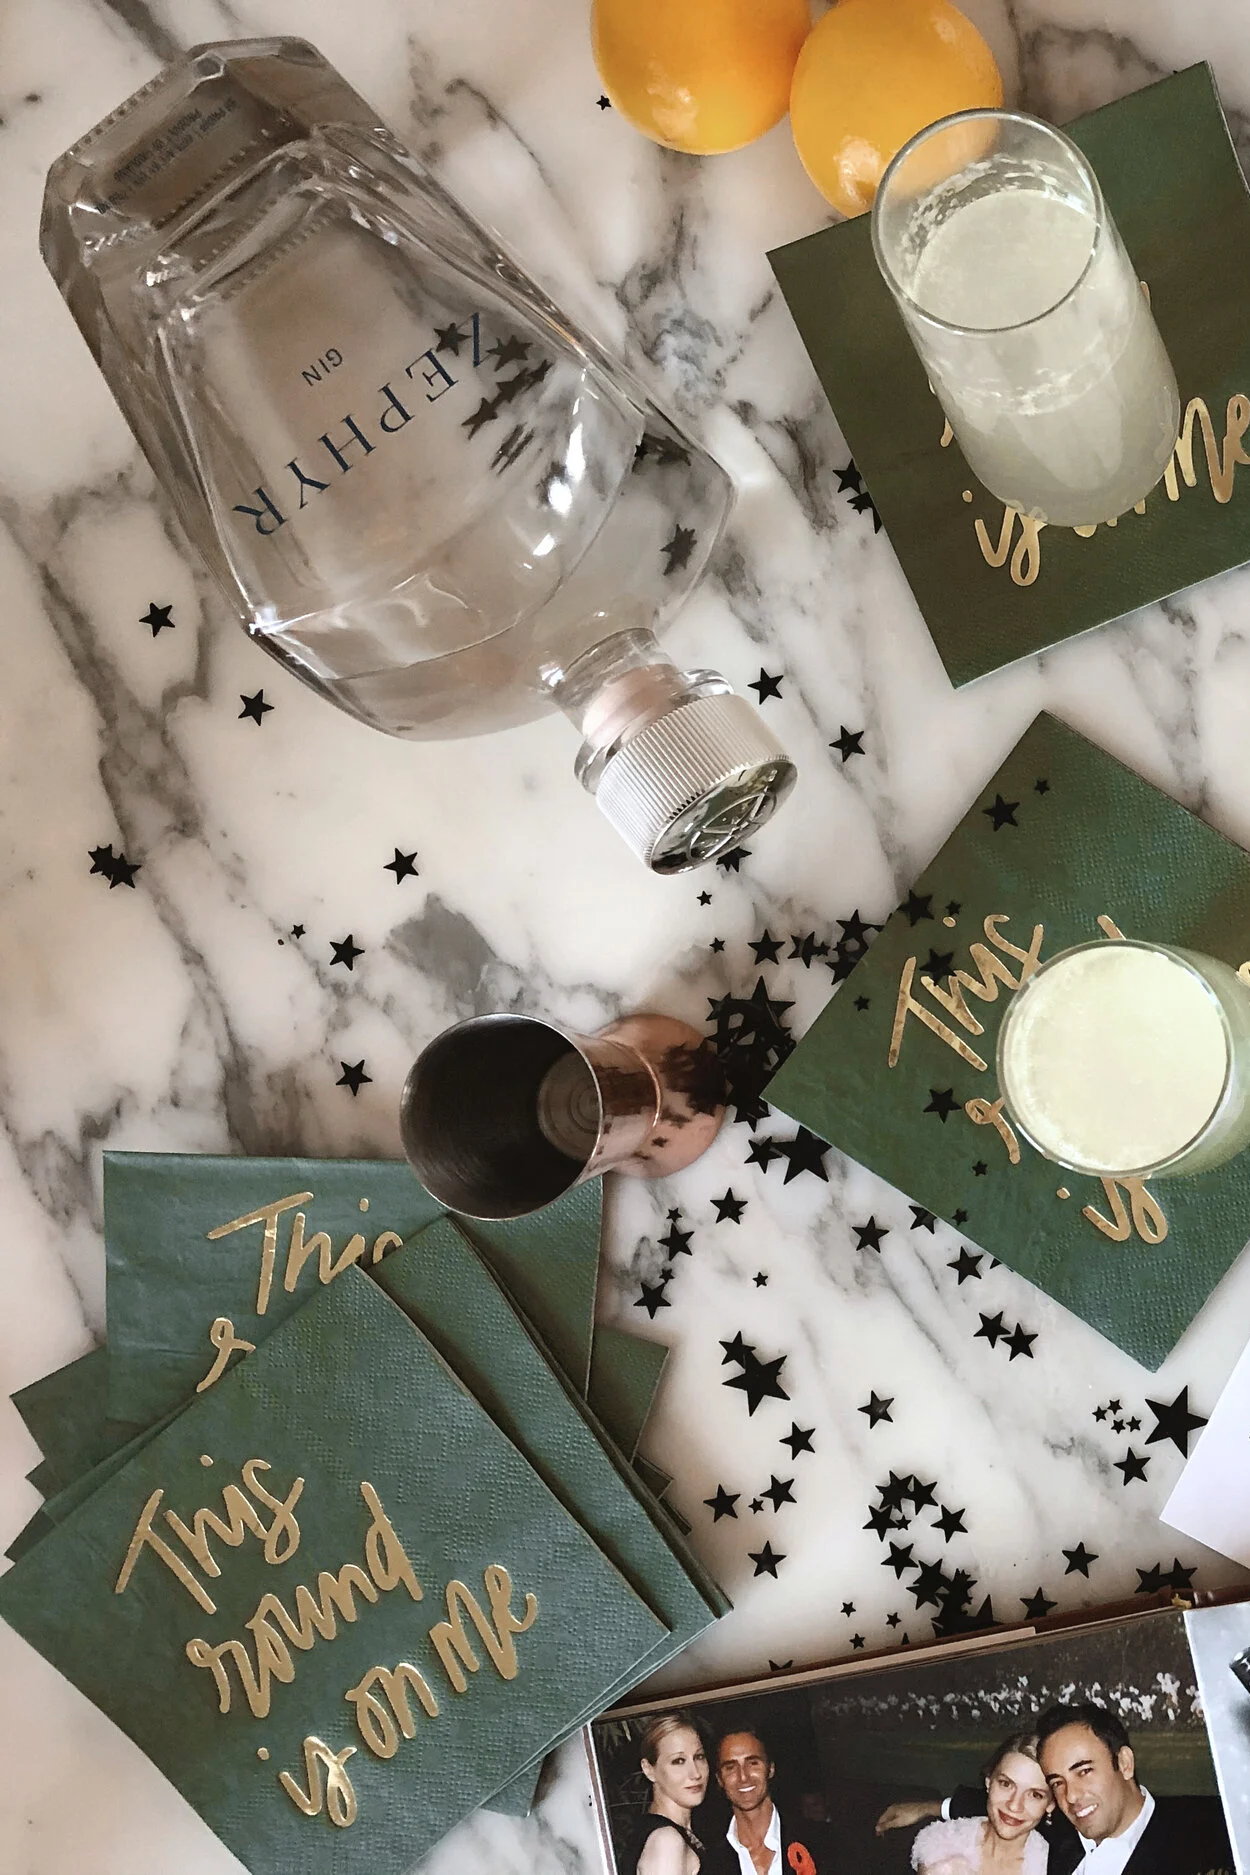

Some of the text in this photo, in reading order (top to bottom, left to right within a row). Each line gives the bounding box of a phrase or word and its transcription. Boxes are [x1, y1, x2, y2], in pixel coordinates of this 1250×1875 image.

[232, 311, 499, 536] ZEPHYR
[301, 347, 344, 387] GIN
[115, 1454, 305, 1615] This
[185, 1480, 424, 1718] round
[256, 1735, 358, 1828] is
[345, 1661, 440, 1759] on
